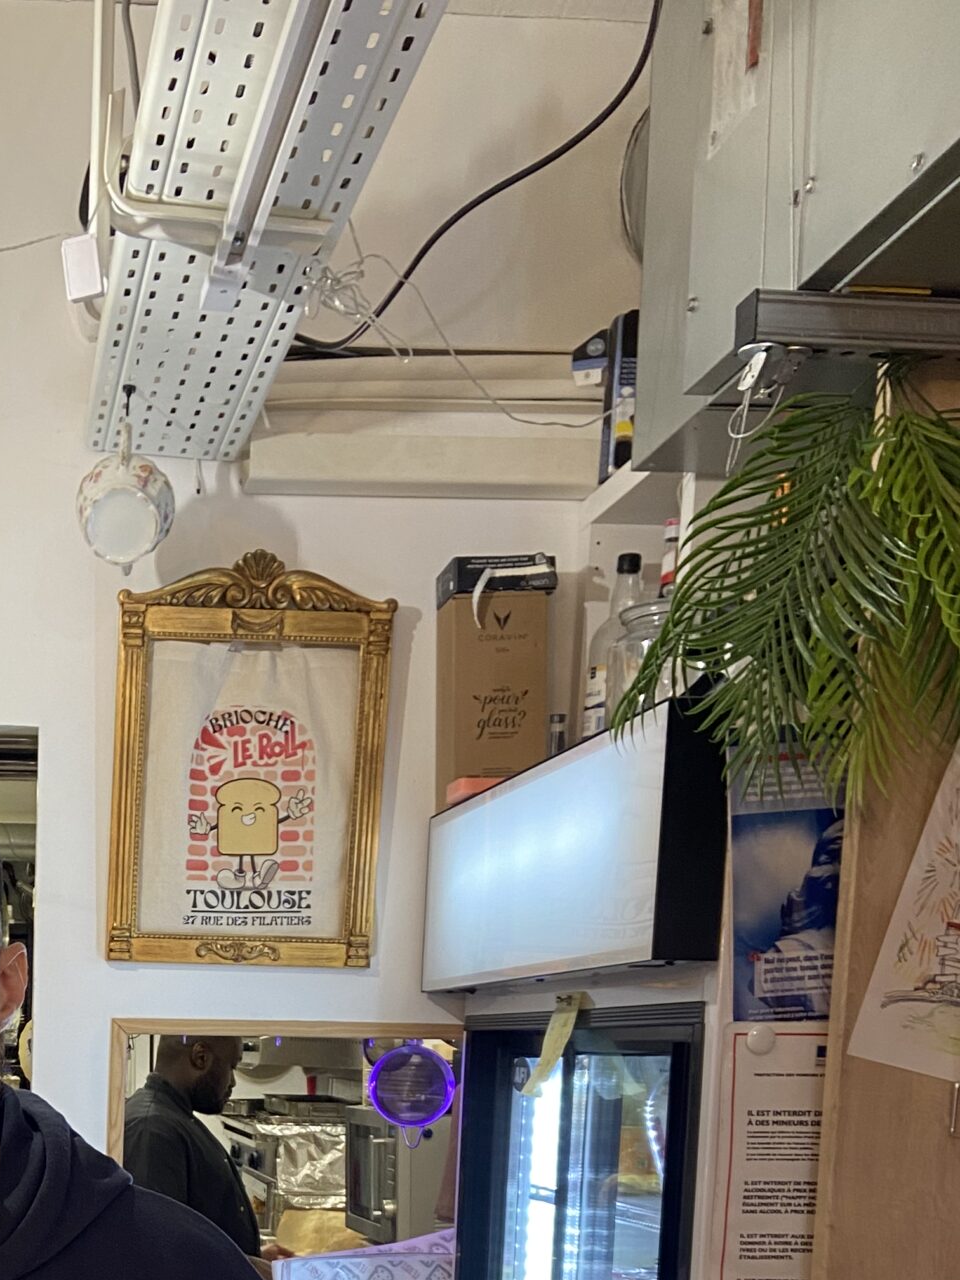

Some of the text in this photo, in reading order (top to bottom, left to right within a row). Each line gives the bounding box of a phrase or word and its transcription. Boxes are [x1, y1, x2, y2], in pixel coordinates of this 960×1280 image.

[209, 708, 295, 735] BRIOCHE
[475, 708, 526, 741] glass?
[233, 738, 253, 769] LE
[185, 888, 312, 910] TOULOUSE
[182, 914, 312, 927] 27 RUE DES FILATIERS
[747, 1118, 754, 1126] À
